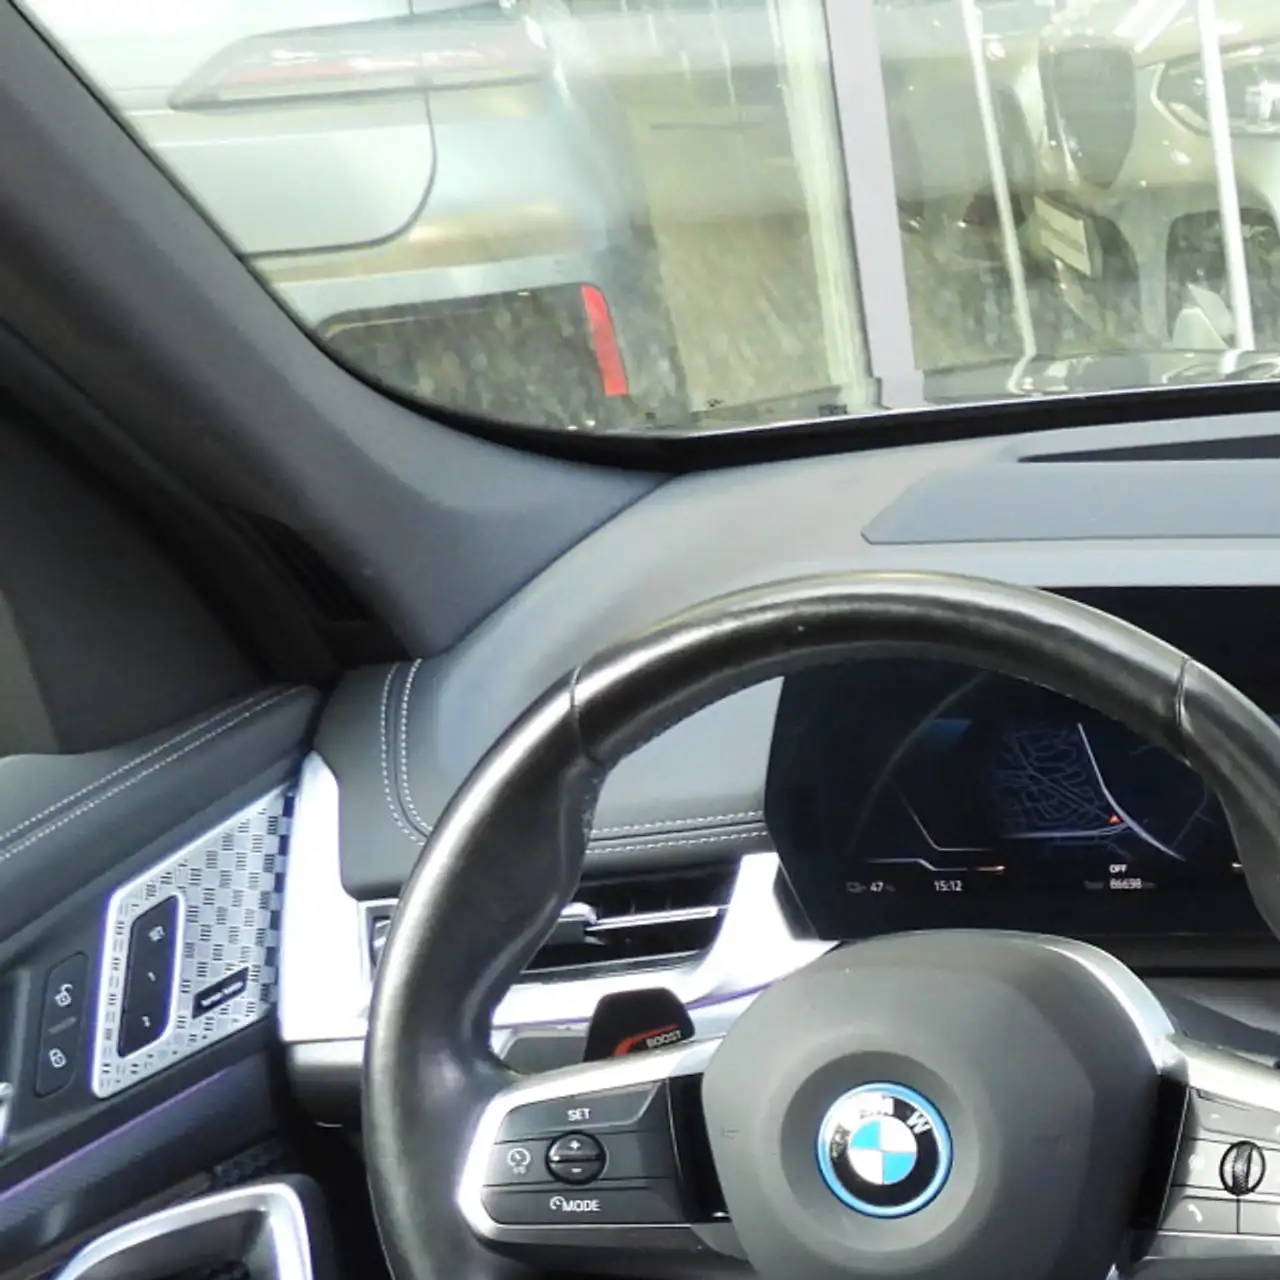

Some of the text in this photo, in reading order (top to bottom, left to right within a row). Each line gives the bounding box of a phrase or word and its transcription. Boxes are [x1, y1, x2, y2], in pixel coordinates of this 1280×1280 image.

[870, 881, 884, 892] 47
[934, 880, 962, 891] 15:12
[646, 1030, 682, 1048] BOOST
[567, 1108, 591, 1121] SET
[562, 1200, 600, 1211] MODE
